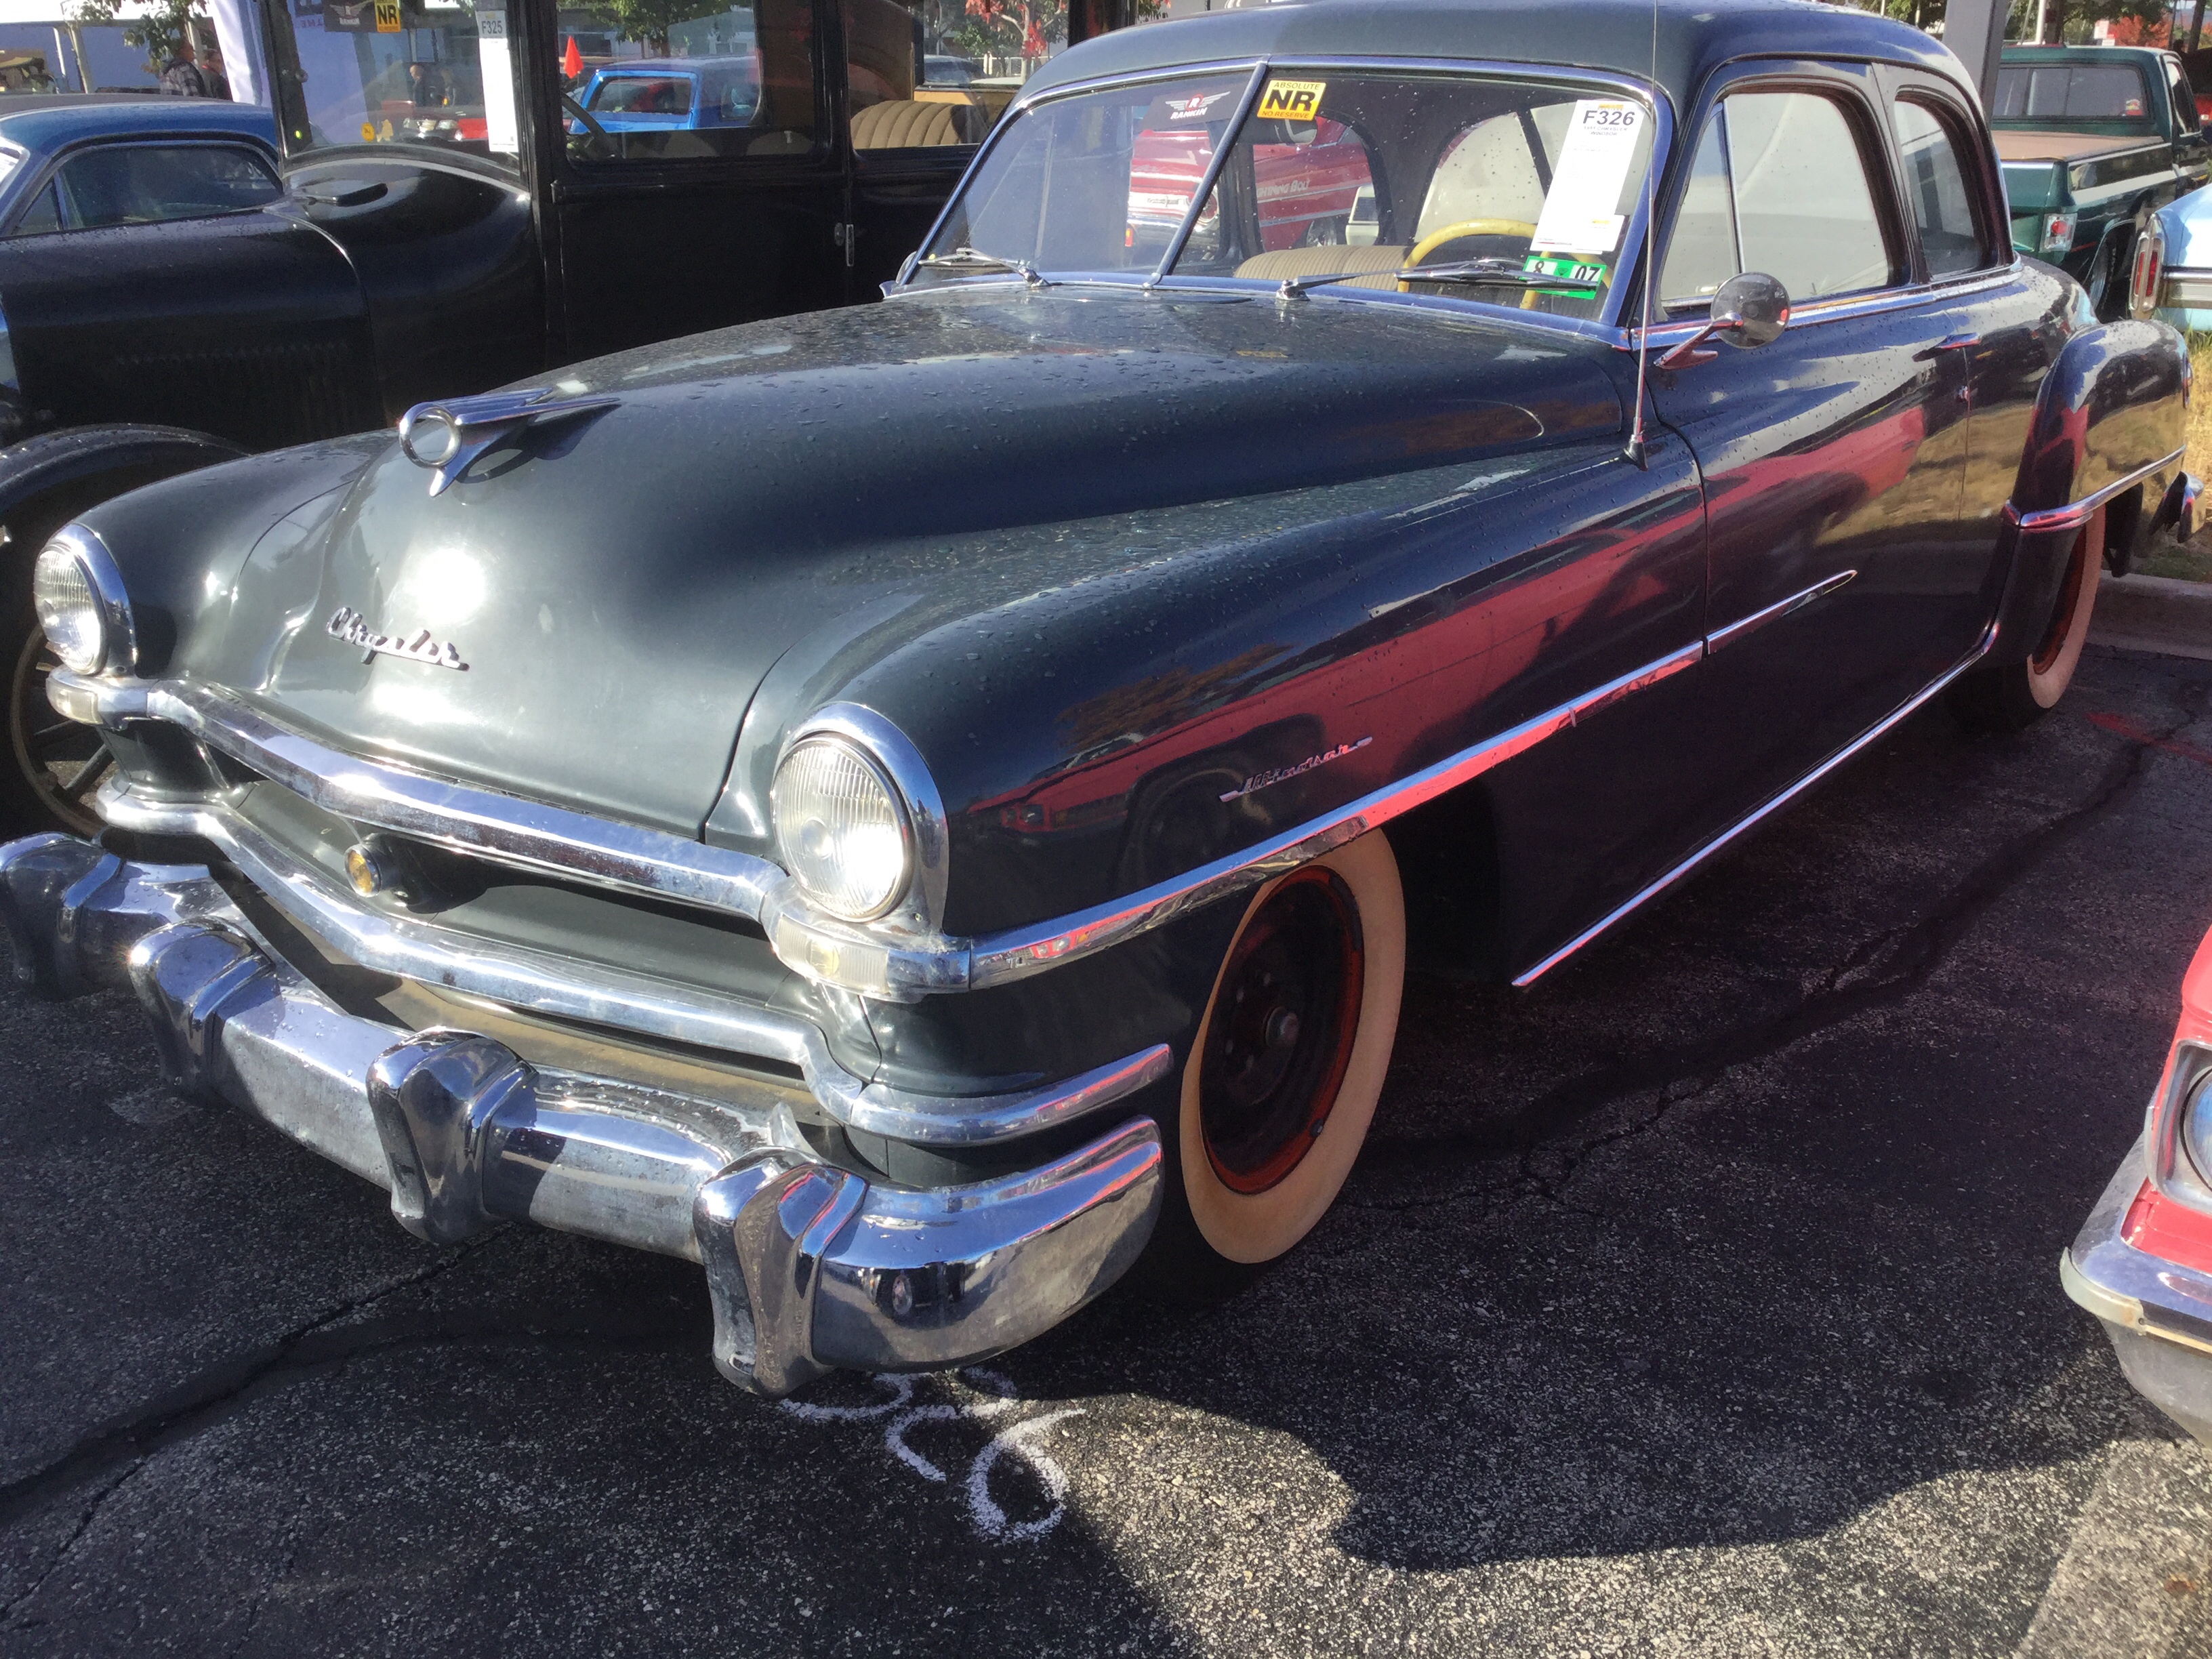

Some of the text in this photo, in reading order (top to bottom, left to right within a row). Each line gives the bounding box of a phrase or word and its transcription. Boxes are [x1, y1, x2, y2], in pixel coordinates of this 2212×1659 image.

[377, 5, 398, 24] NR
[481, 20, 503, 35] F325
[1274, 81, 1321, 90] ABSOLUTE
[1188, 97, 1200, 108] R
[1265, 89, 1316, 112] NR
[1170, 106, 1208, 120] RANKIN
[1582, 110, 1635, 126] F326
[1574, 265, 1601, 282] 07
